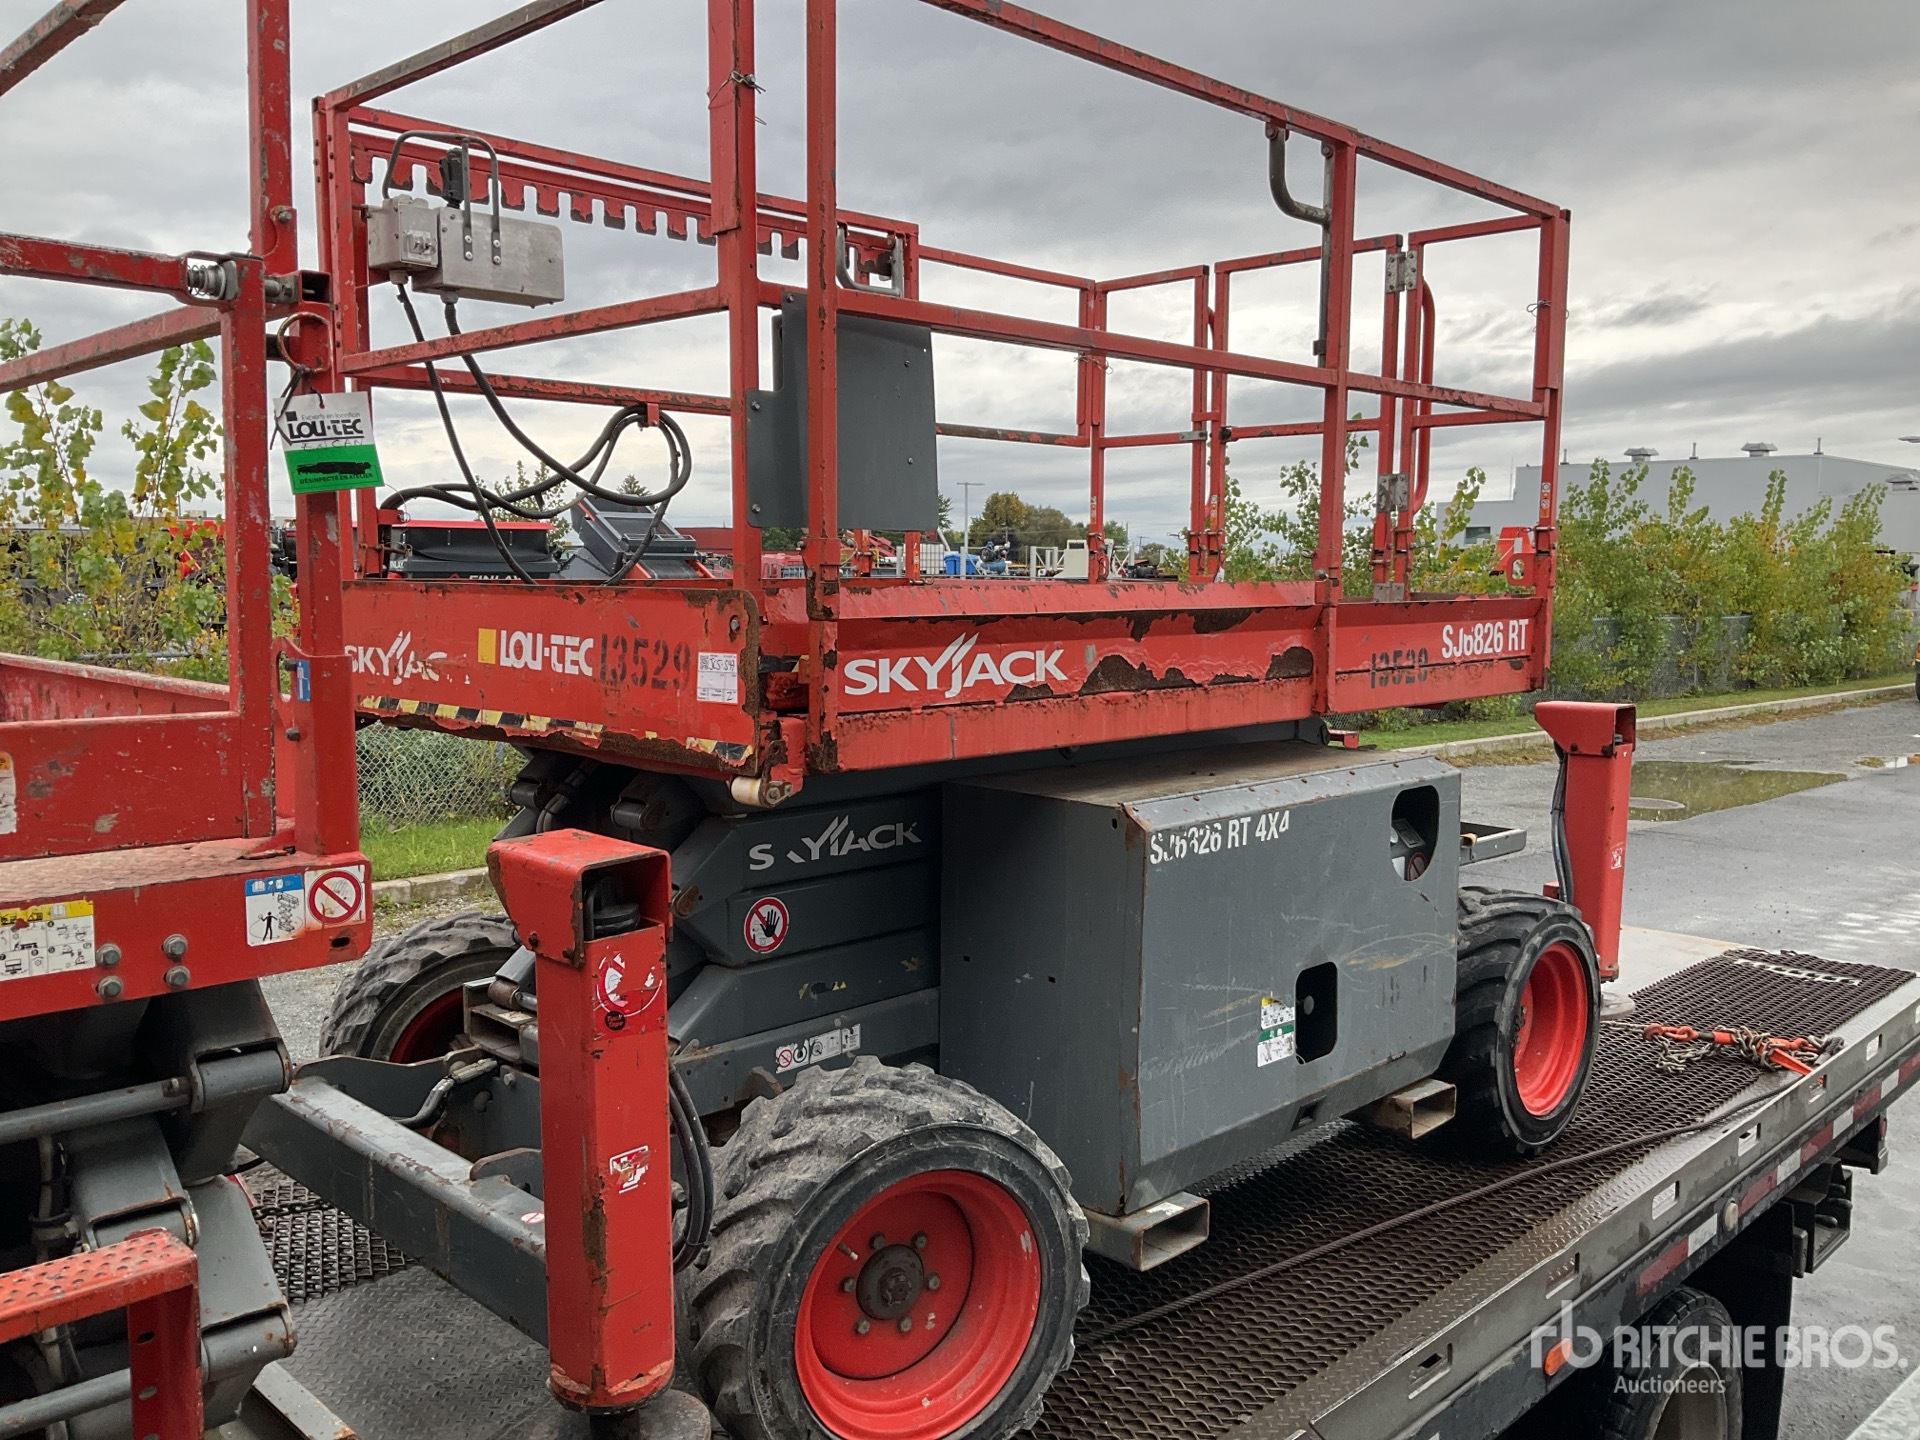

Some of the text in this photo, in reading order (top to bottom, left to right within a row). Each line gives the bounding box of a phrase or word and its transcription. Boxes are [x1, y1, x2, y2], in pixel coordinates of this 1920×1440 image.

[601, 632, 691, 689] 13529
[1508, 618, 1529, 651] RT
[844, 632, 1068, 699] SKYJACK
[749, 815, 922, 871] SYJACK
[1227, 816, 1251, 849] RT
[1255, 810, 1290, 842] 4X4
